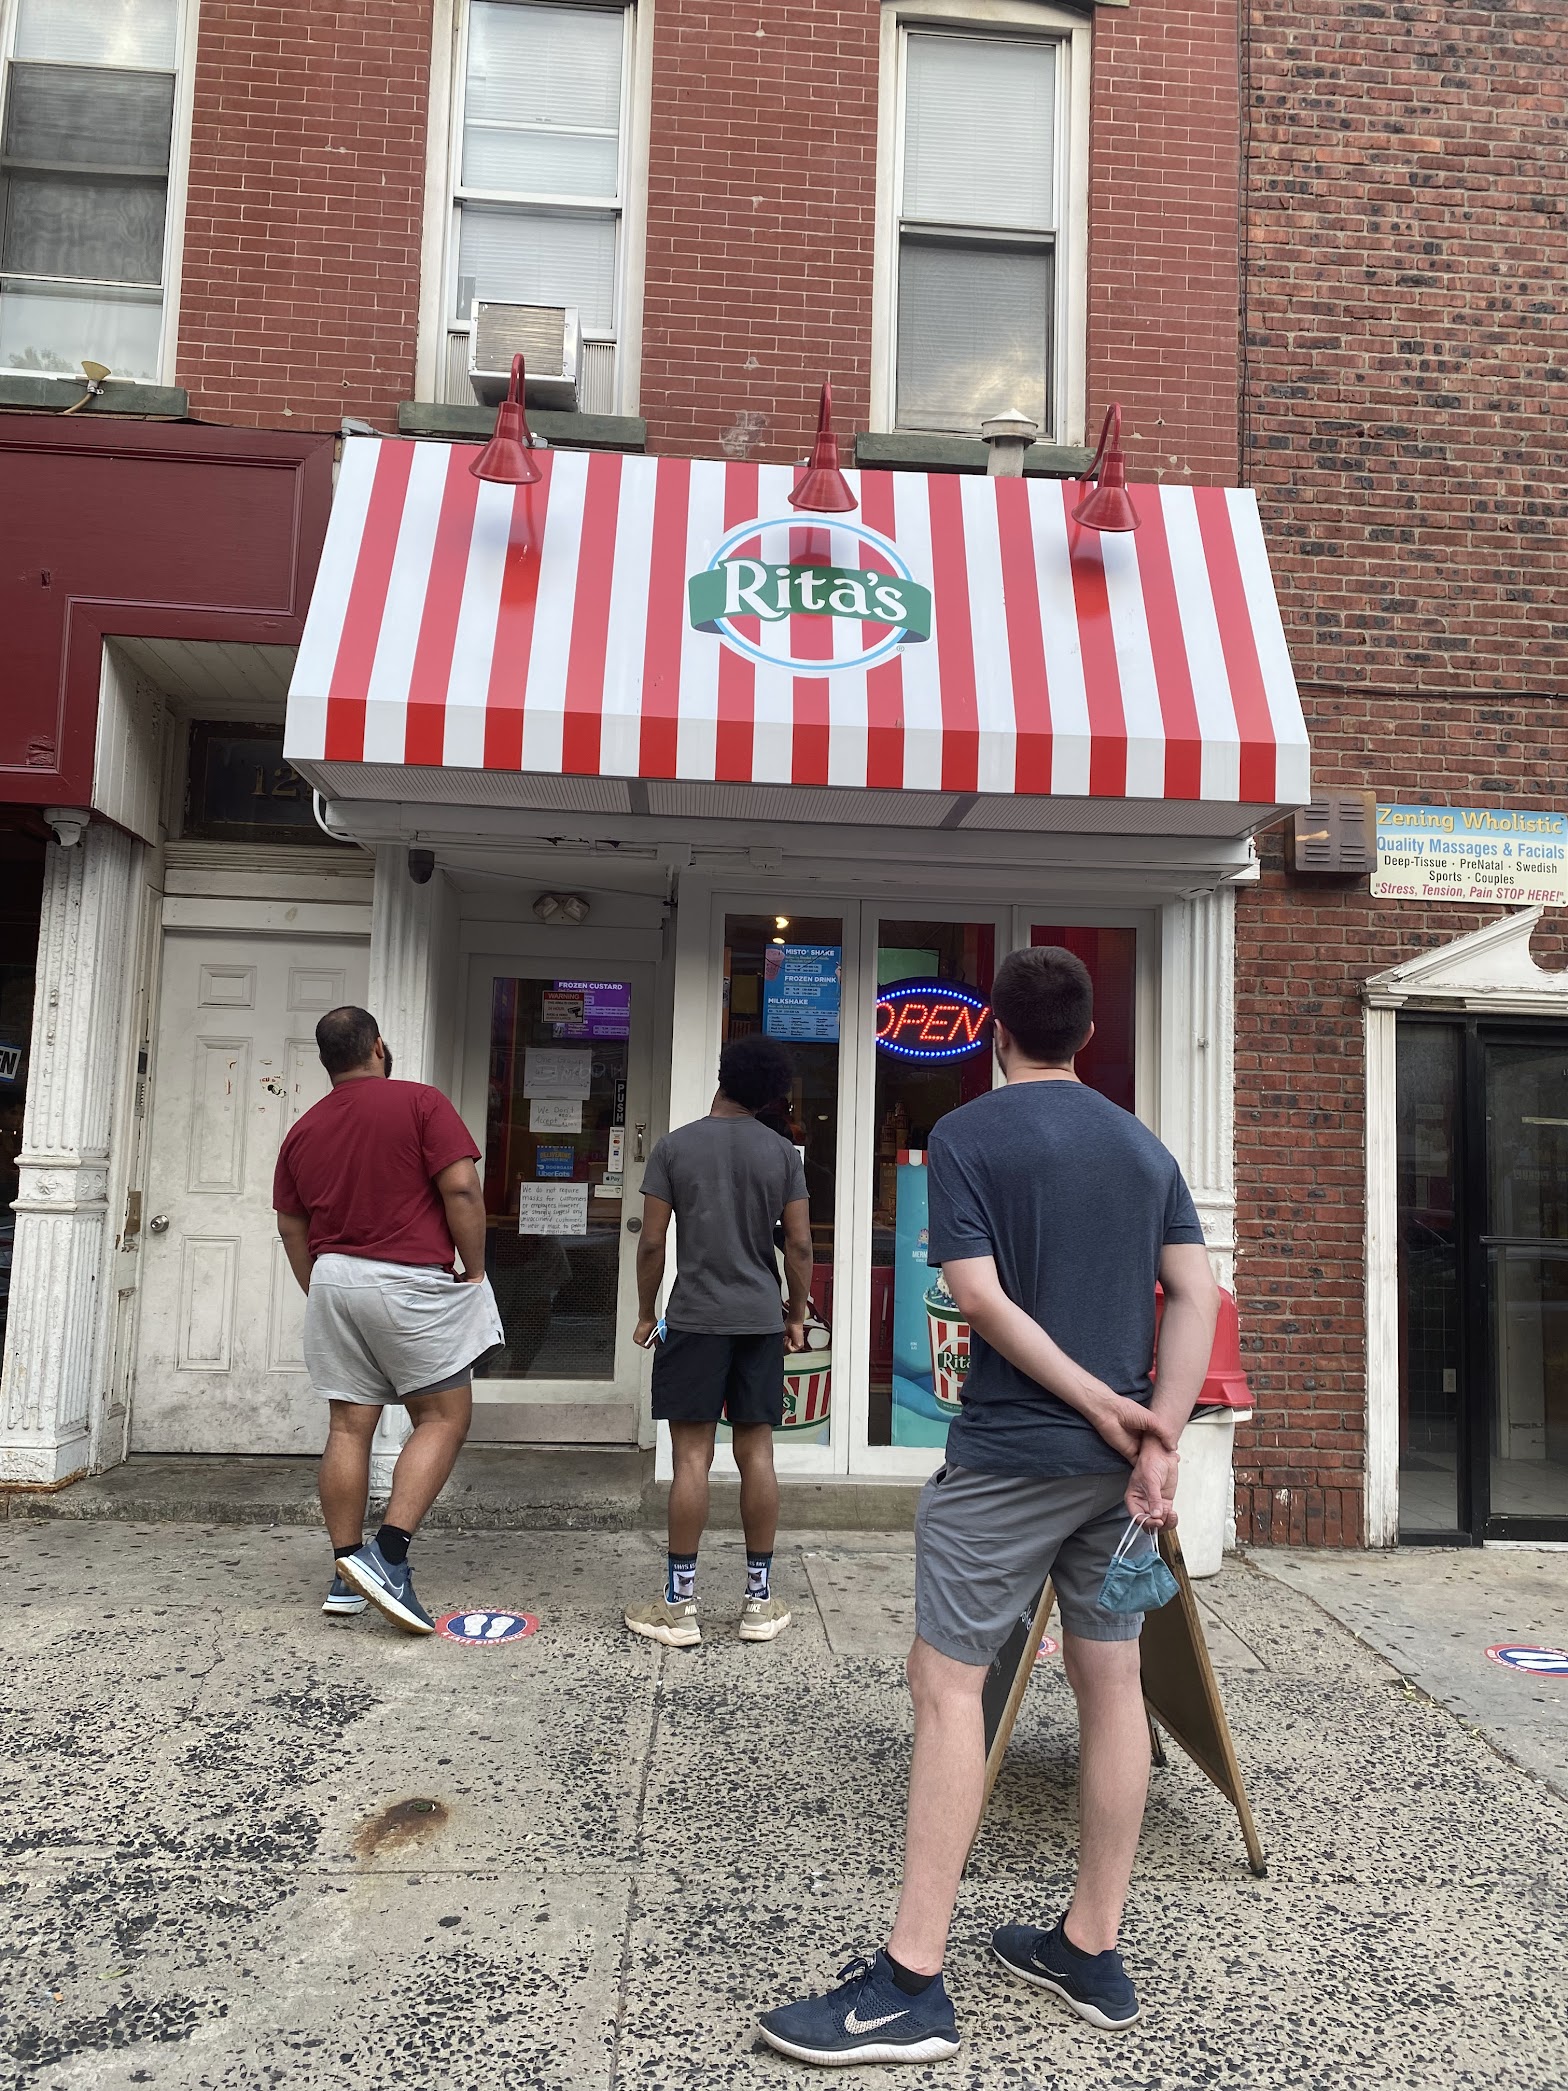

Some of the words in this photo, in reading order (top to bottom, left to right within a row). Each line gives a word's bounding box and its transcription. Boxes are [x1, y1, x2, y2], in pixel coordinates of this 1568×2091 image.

[724, 559, 908, 621] Rita's
[250, 765, 312, 797] 12
[1377, 807, 1455, 833] Zening
[1461, 811, 1563, 834] Wholistic
[1377, 836, 1424, 855] Quality
[1429, 839, 1498, 857] Massages
[1503, 843, 1513, 856] &
[1518, 843, 1565, 859] Facials
[1384, 855, 1447, 868] Deep-Tissue
[1460, 859, 1503, 871] PreNatal
[1516, 862, 1558, 873] Swedish
[1429, 871, 1462, 883] Sports
[1475, 872, 1515, 885] Couples
[1422, 884, 1466, 898] Tension,
[1469, 887, 1493, 898] Pain
[1496, 887, 1524, 900] STOP
[810, 949, 835, 957] SHAKE
[767, 997, 809, 1005] MILKSHAKE
[876, 1002, 990, 1042] OPEN
[537, 1106, 549, 1114] We
[616, 1083, 625, 1122] PUSH
[534, 1117, 557, 1126] Accept
[522, 1185, 531, 1193] We
[536, 1185, 542, 1193] do
[912, 1250, 928, 1258] MERM
[944, 1351, 971, 1371] Rit
[684, 1604, 698, 1616] NIK
[746, 1603, 761, 1613] NIKE
